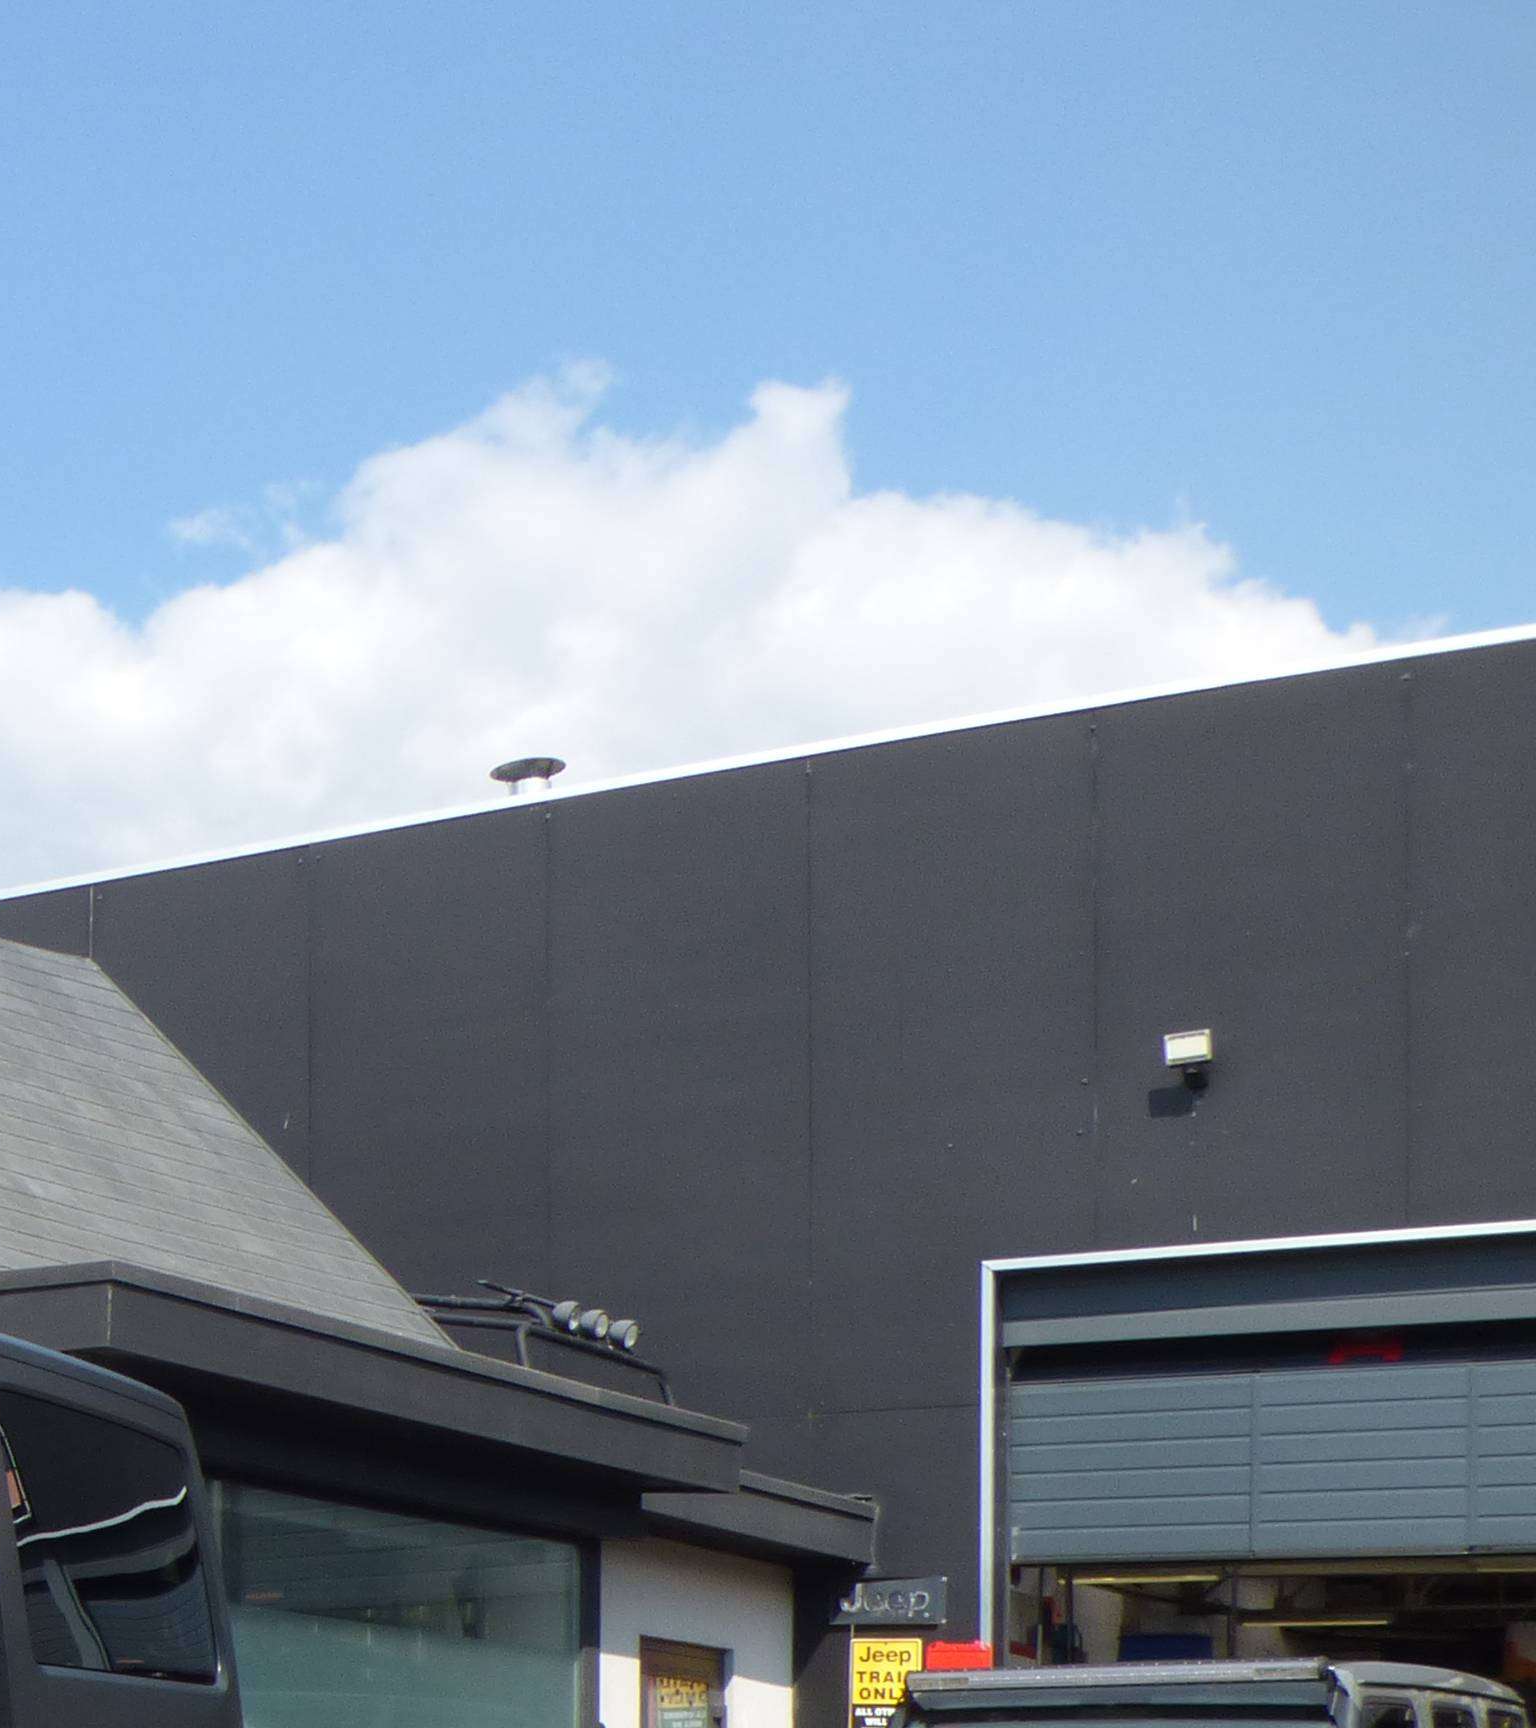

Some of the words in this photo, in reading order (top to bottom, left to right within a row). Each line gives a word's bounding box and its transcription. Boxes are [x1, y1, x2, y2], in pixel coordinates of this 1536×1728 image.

[840, 1582, 930, 1617] Jeep
[859, 1646, 911, 1666] Jeep
[856, 1671, 902, 1683] TRAI
